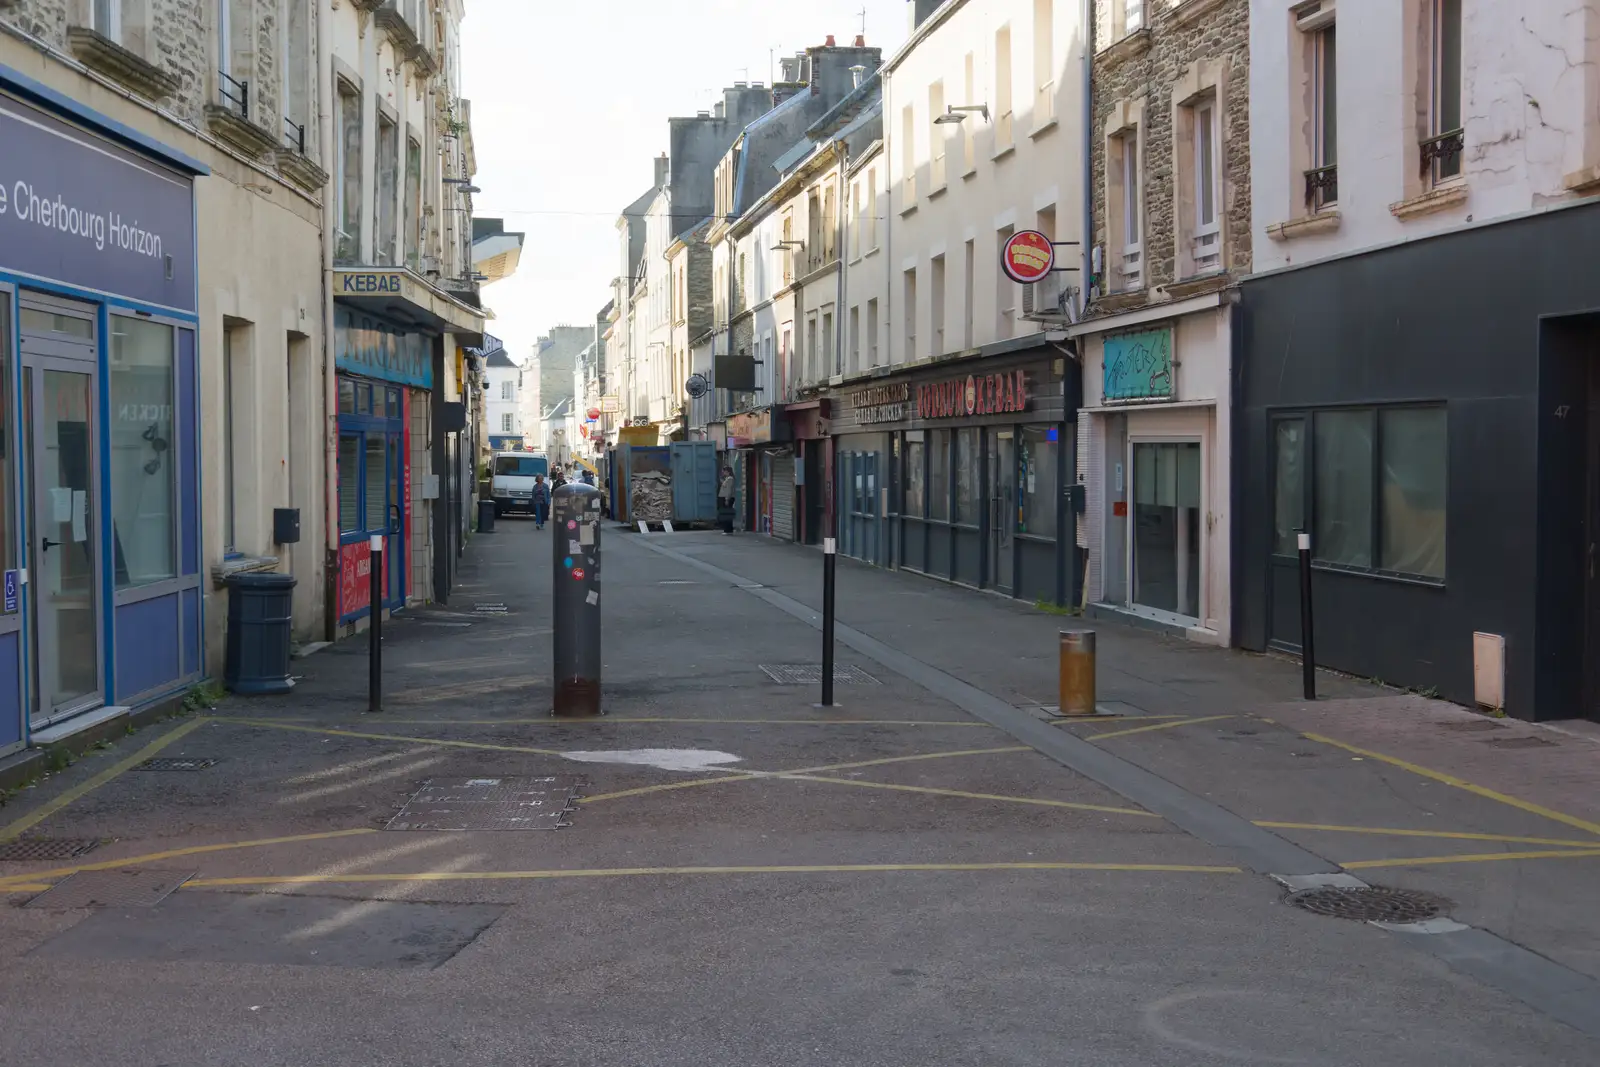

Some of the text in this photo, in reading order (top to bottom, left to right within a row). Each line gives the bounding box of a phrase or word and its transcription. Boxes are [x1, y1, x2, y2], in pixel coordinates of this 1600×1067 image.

[14, 180, 105, 250] Cherbourg
[109, 211, 162, 259] Horizon
[343, 274, 400, 292] KEBAB
[976, 370, 1026, 415] KEBAB
[1553, 405, 1571, 420] 47
